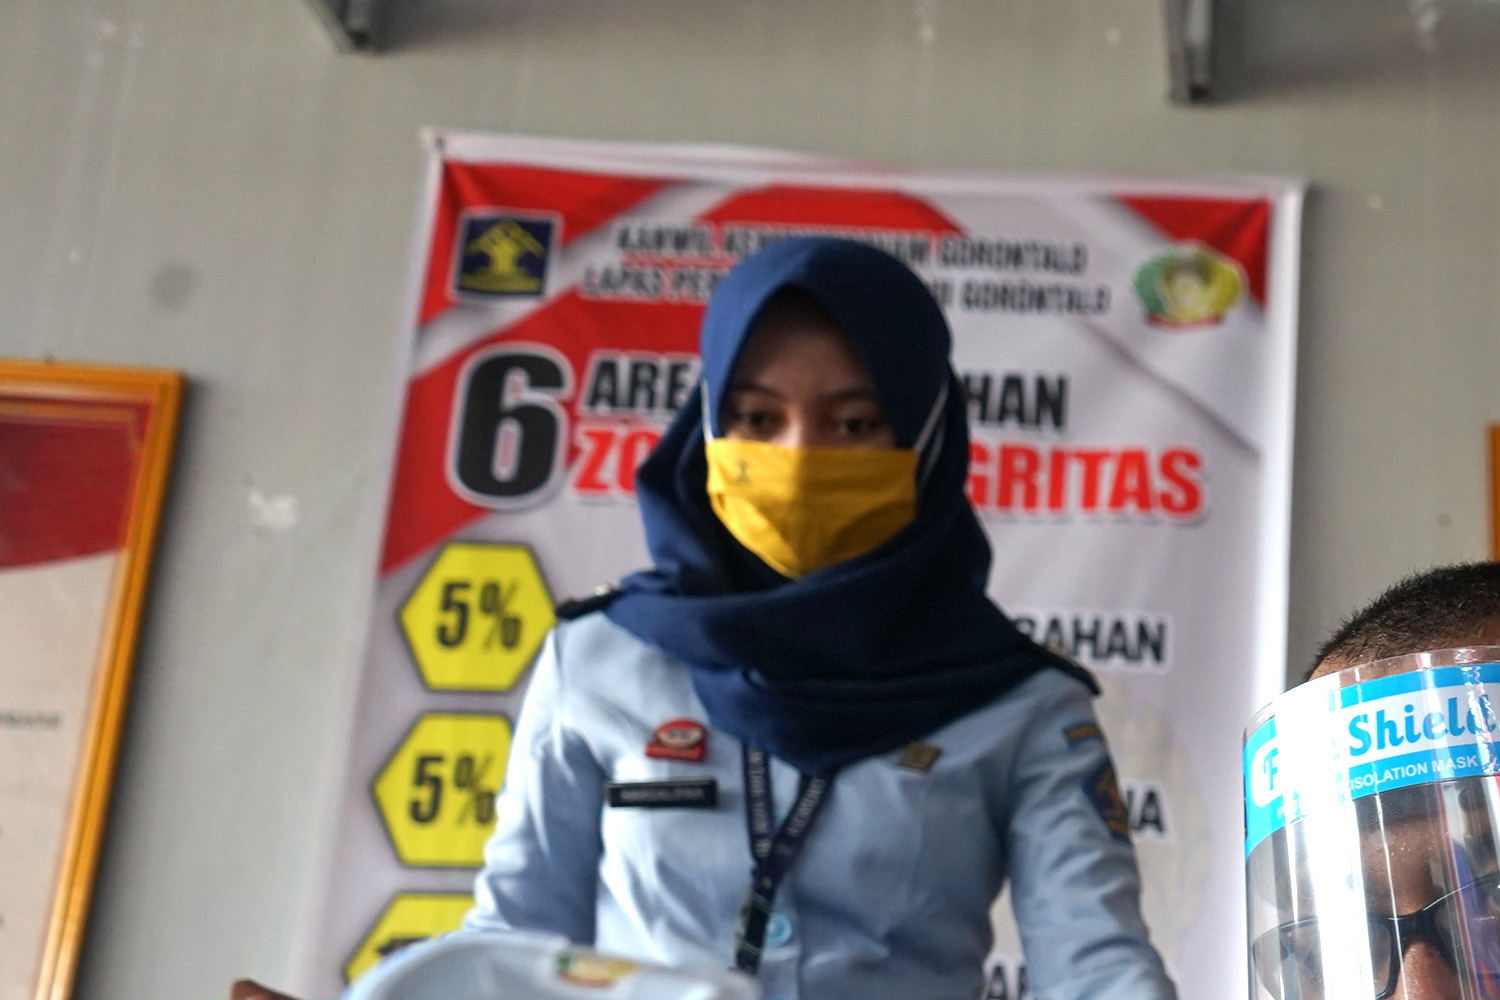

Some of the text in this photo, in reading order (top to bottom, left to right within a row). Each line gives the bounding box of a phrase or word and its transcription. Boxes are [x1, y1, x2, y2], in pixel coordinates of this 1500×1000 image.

[454, 352, 566, 499] 6
[584, 359, 1067, 428] ARE HAN
[574, 429, 1204, 518] ZO GRITAS
[436, 581, 522, 649] 5%
[1015, 616, 1166, 663] AHAN
[1348, 694, 1497, 757] Shield
[409, 755, 499, 827] 5%
[1350, 754, 1479, 790] ISOLATION MASK
